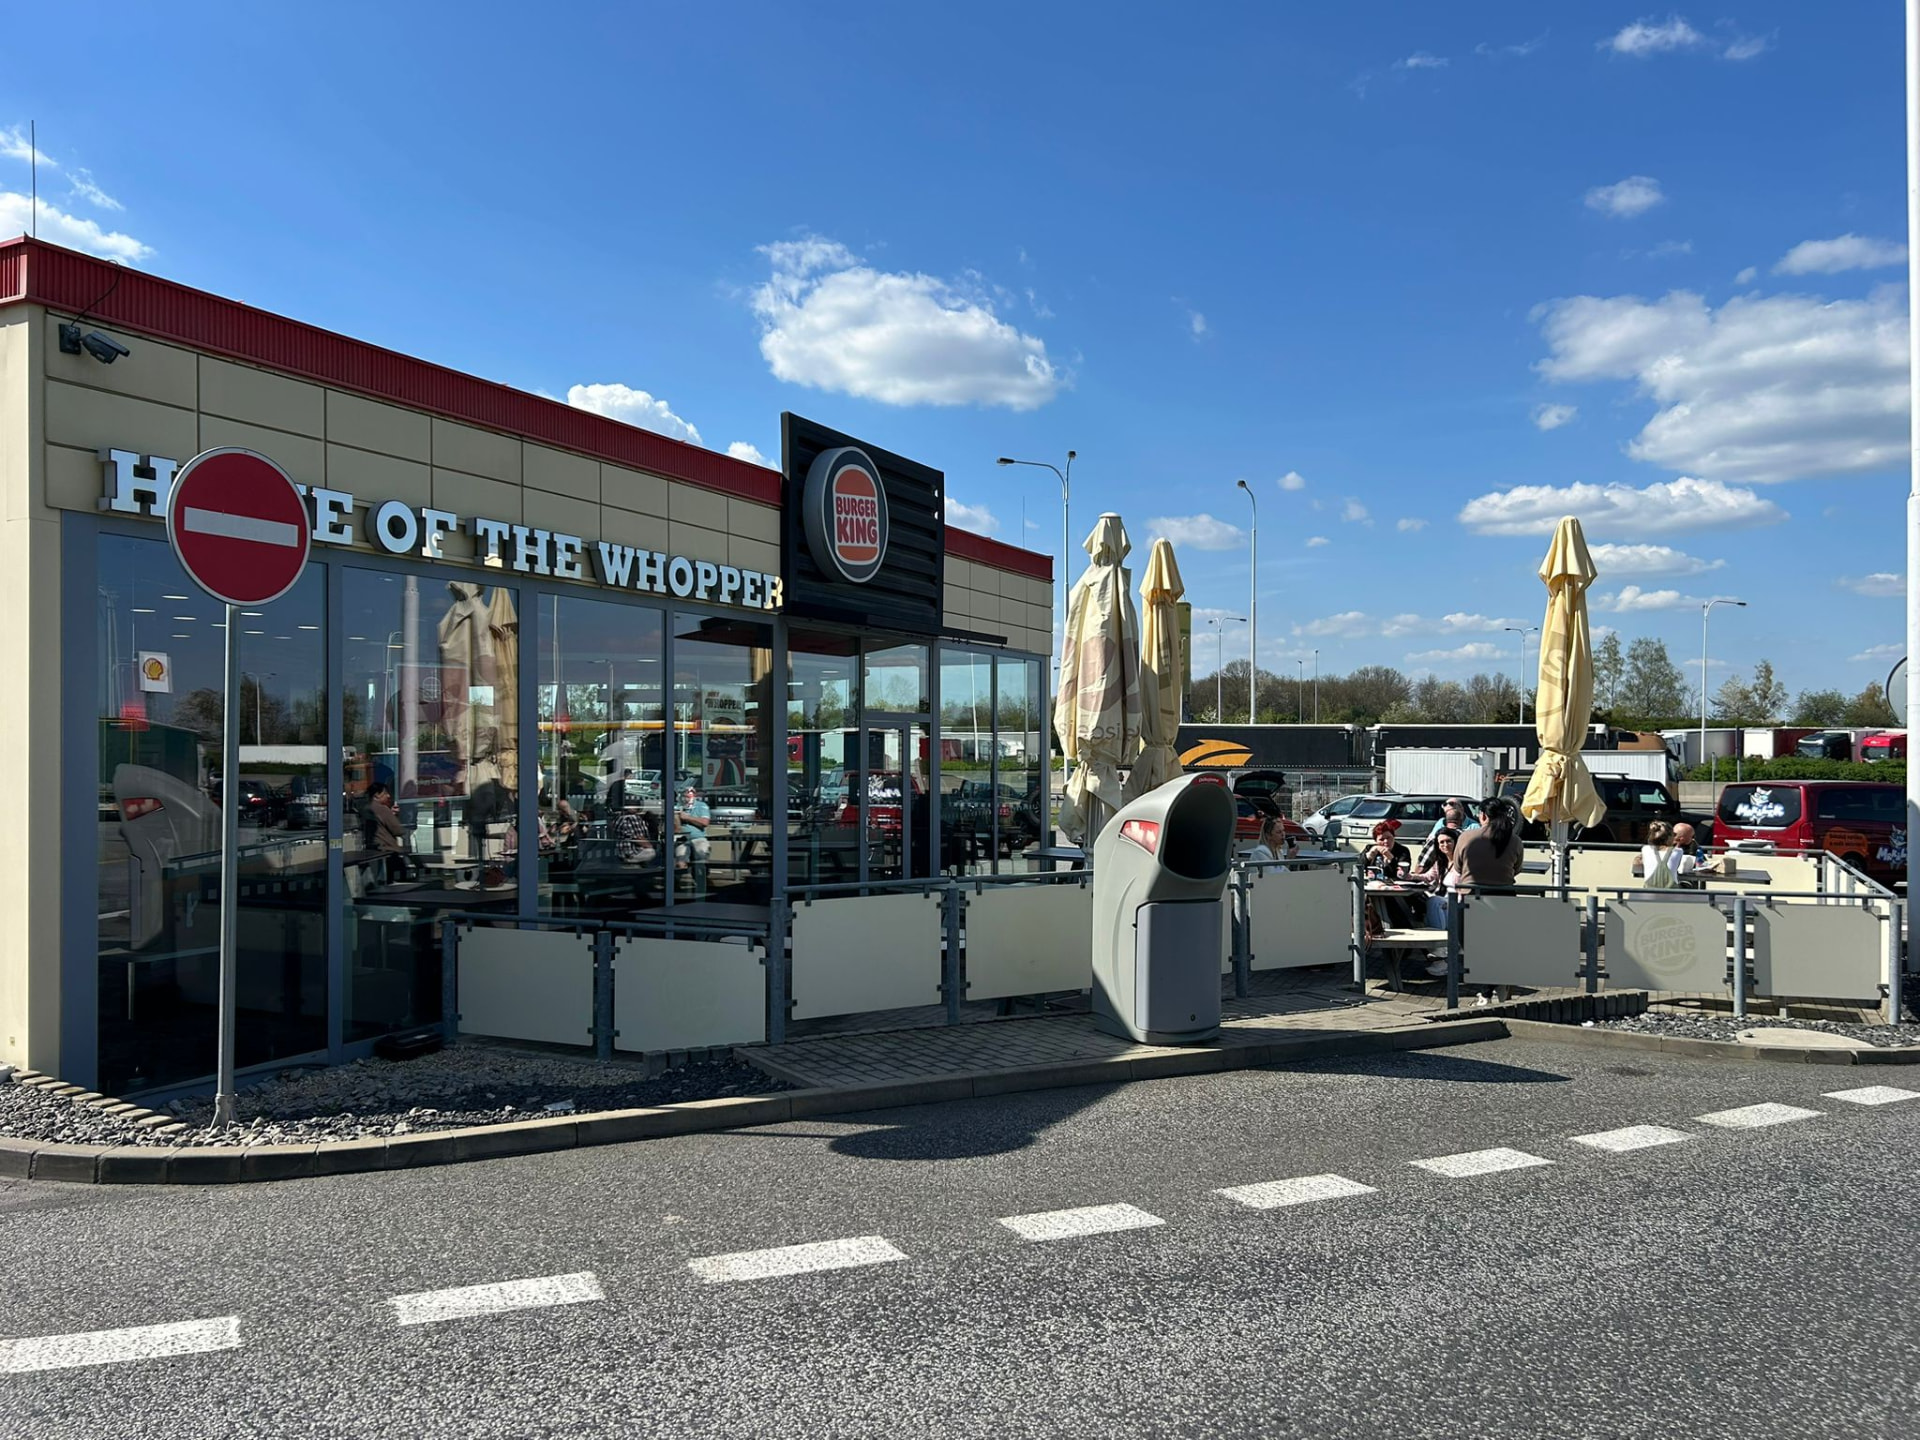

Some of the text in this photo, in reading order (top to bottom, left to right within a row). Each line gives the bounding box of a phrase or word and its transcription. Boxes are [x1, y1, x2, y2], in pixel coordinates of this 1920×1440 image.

[835, 496, 877, 518] BURGER
[108, 448, 784, 610] HE OF THE WHOPPER
[836, 516, 878, 544] KING
[1641, 925, 1694, 946] BURGER
[1643, 936, 1696, 961] KING
